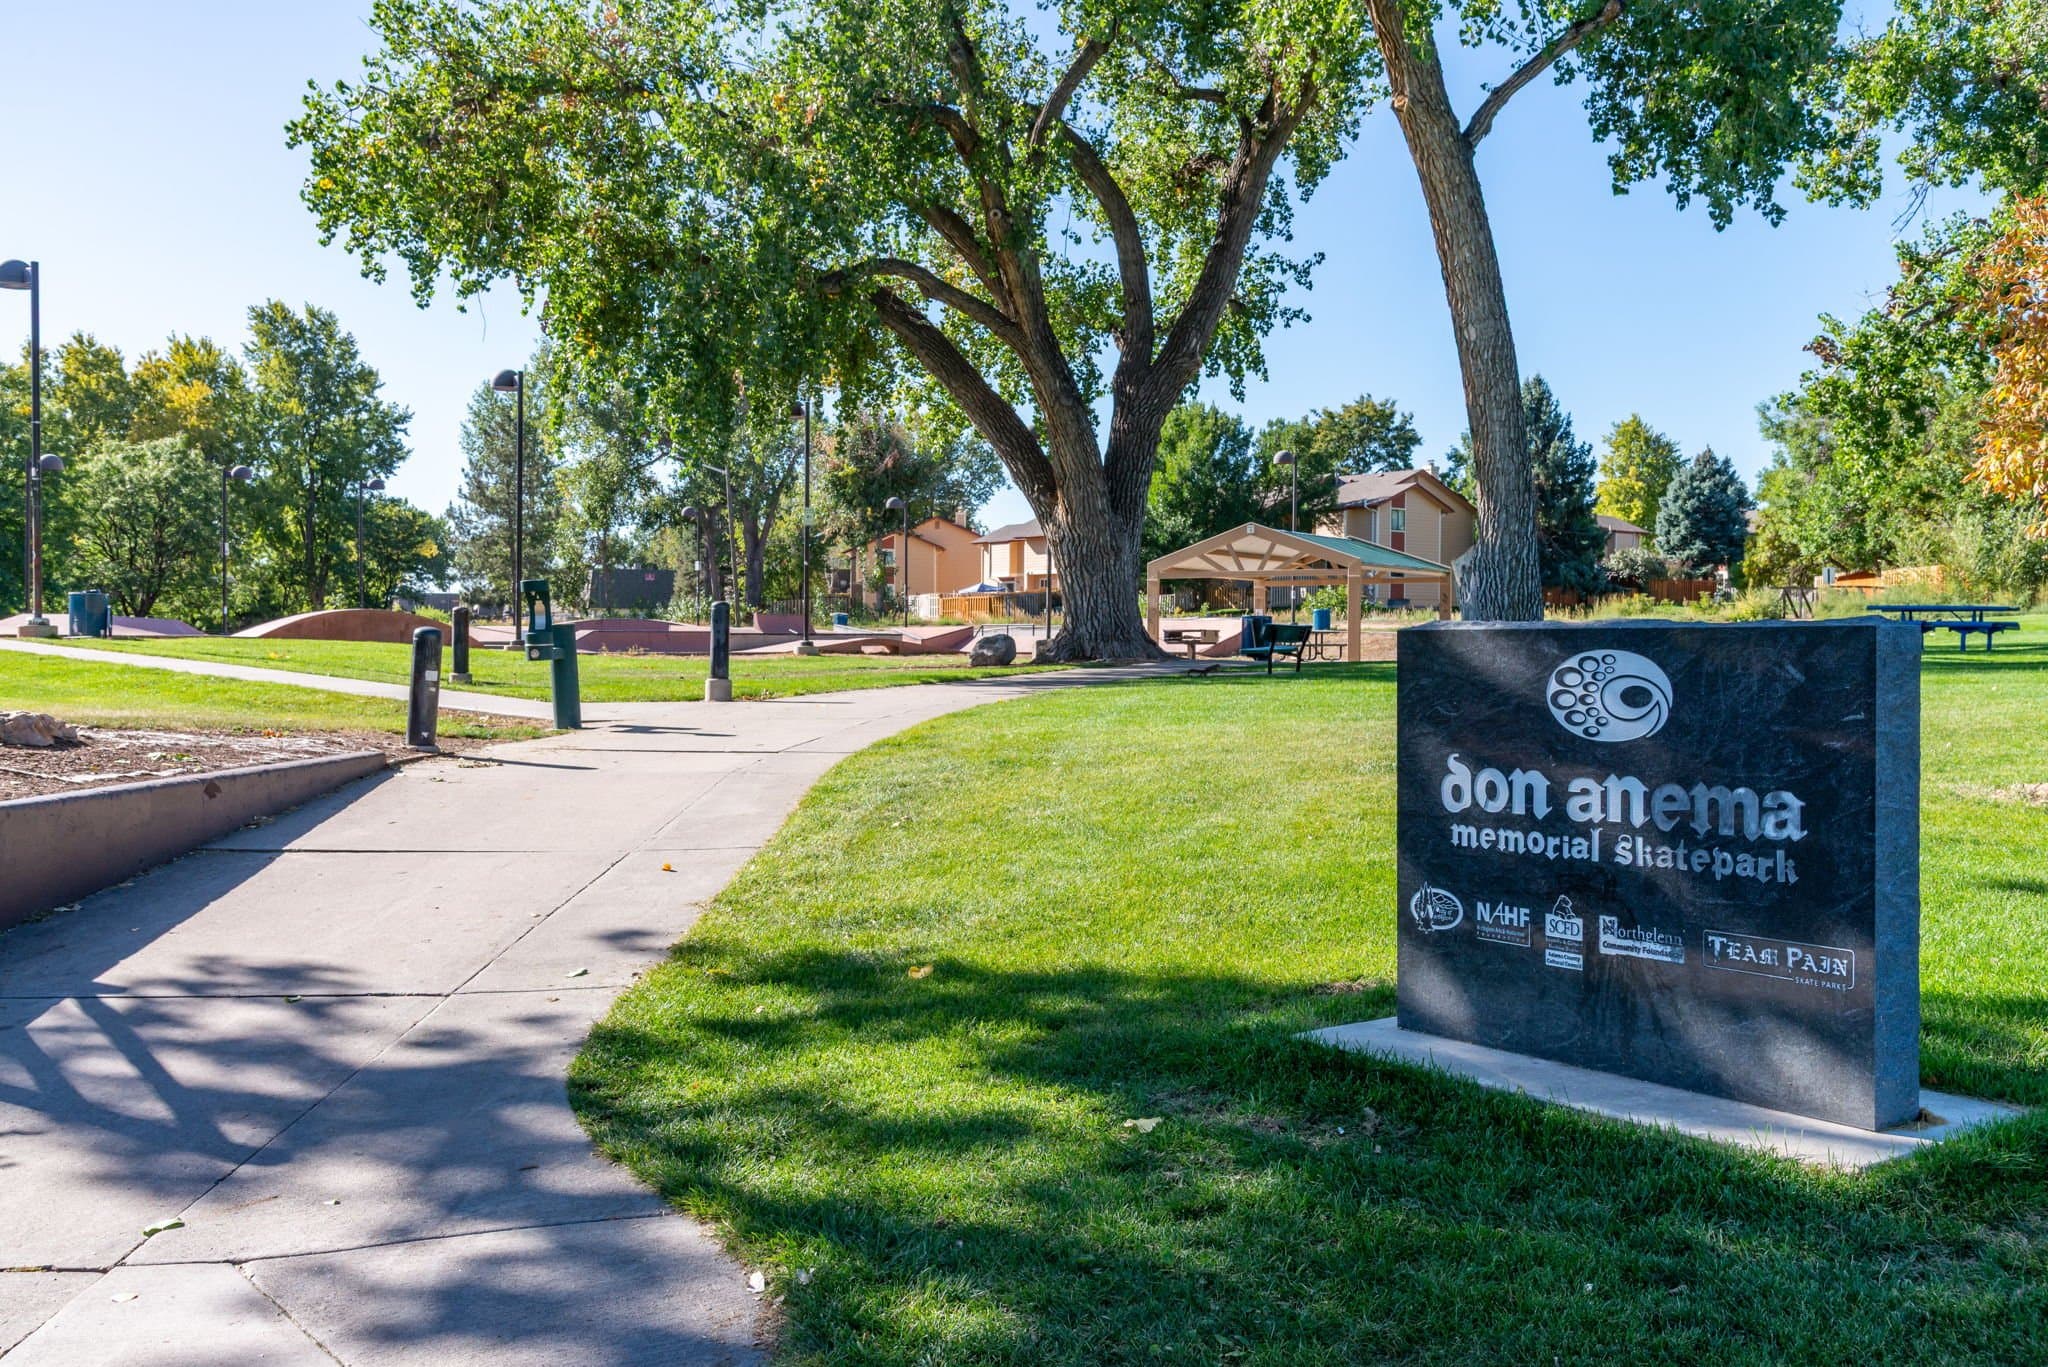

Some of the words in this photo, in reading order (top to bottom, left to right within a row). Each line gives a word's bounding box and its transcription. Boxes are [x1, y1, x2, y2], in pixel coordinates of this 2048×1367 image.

[1441, 753, 1552, 820] don
[1566, 773, 1808, 842] anema
[1450, 823, 1603, 862] memorial
[1477, 901, 1530, 928] NAHF
[1549, 918, 1580, 937] SCFD
[1601, 917, 1683, 946] Northglenn
[1602, 941, 1641, 954] Community
[1795, 977, 1818, 987] SKATE
